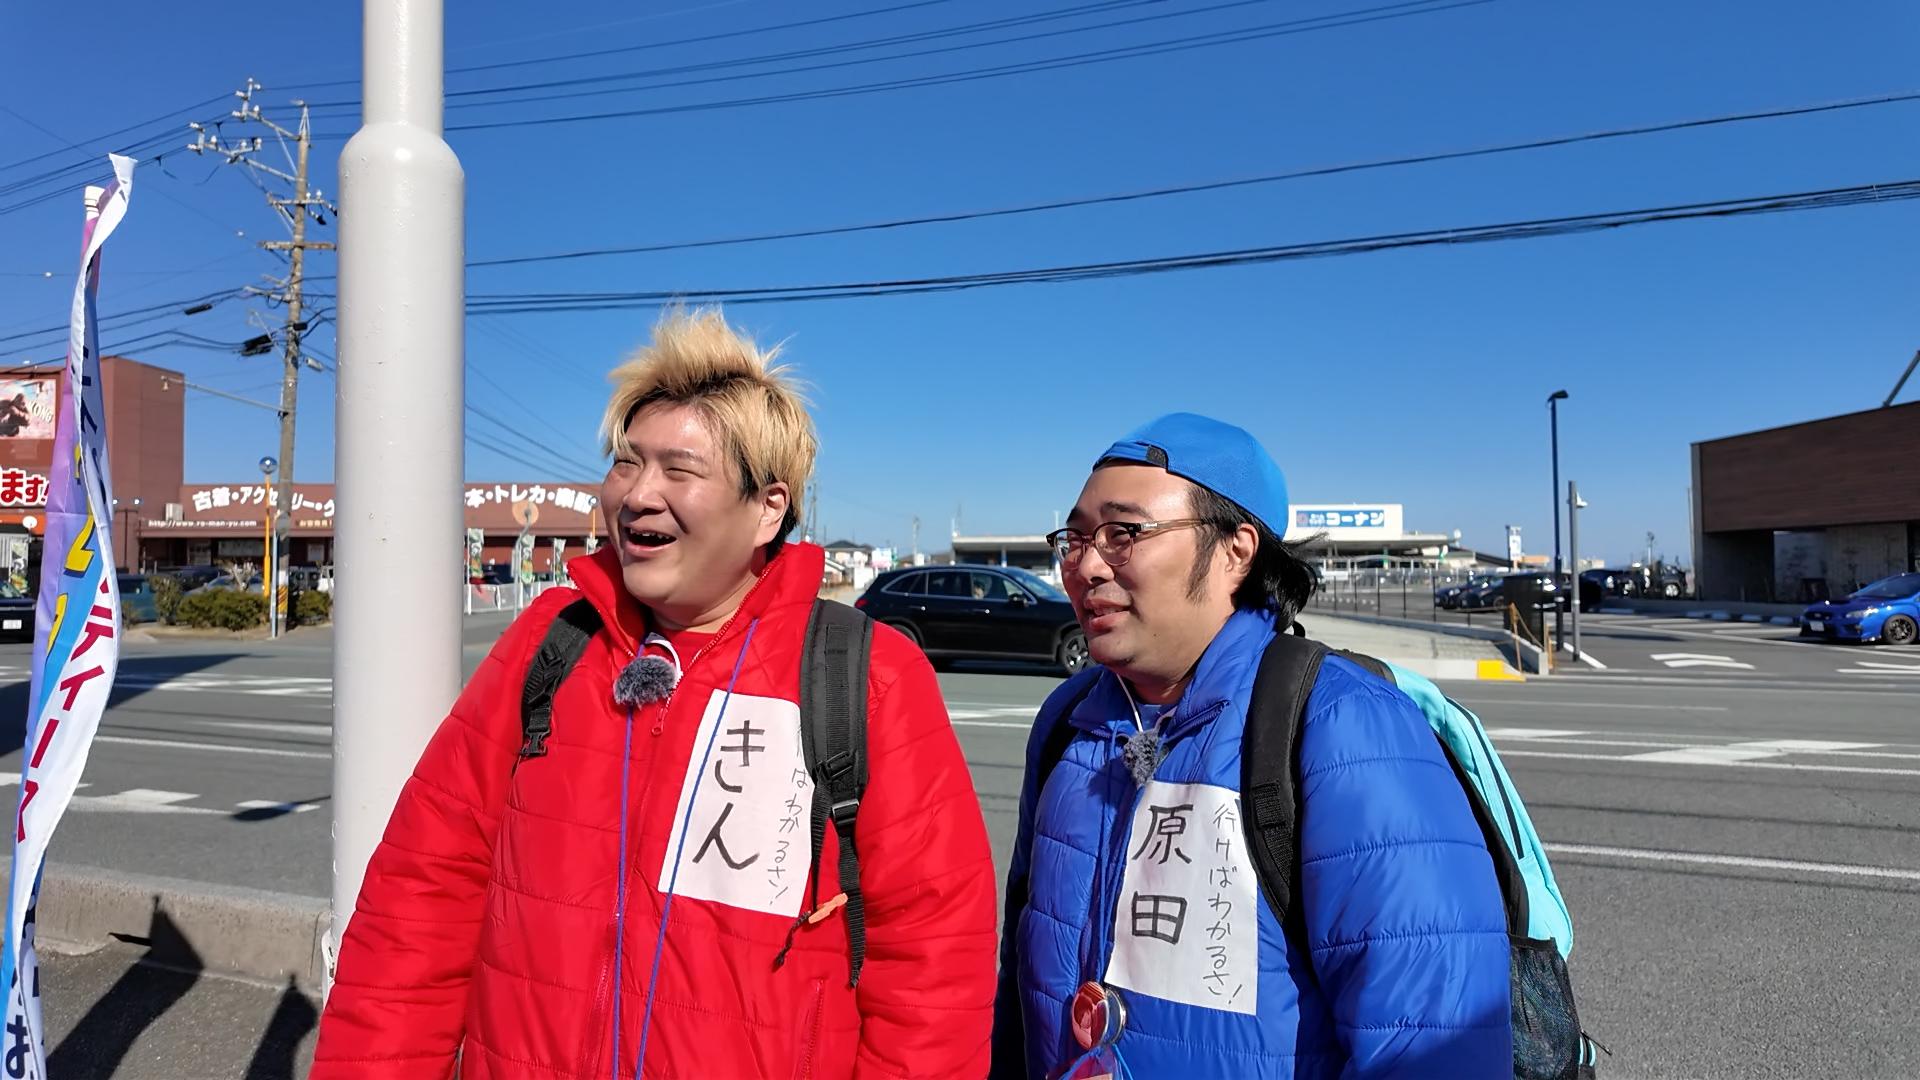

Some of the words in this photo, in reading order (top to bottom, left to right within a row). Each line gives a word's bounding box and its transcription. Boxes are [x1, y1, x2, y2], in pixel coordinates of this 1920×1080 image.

[1326, 512, 1384, 526] コーナン
[692, 719, 766, 870] きん
[1131, 803, 1194, 945] 原田
[1203, 803, 1242, 1005] 行けばわかるさ!
